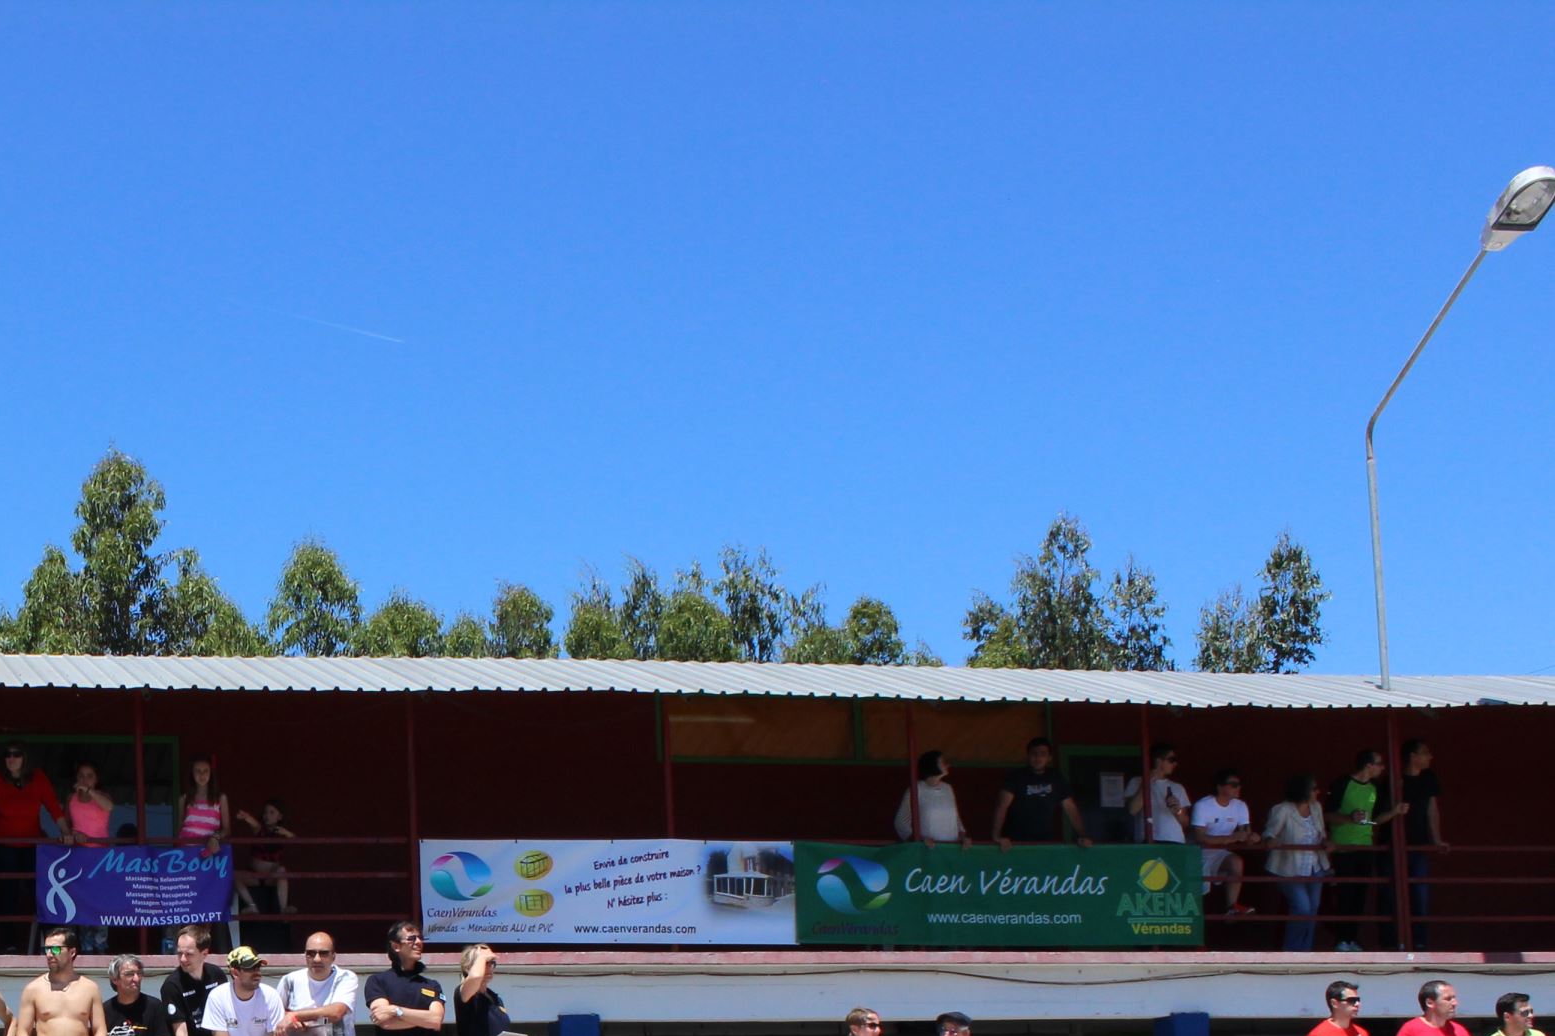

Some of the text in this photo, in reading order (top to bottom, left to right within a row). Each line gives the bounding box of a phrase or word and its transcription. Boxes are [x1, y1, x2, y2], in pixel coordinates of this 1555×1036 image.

[87, 848, 228, 879] Mass Body
[593, 849, 669, 870] Envie de construire
[564, 884, 572, 894] la
[575, 882, 592, 896] plus
[592, 877, 611, 890] belle
[613, 875, 632, 891] pièce
[634, 872, 645, 883] de
[646, 871, 667, 882] votre
[669, 866, 695, 879] maison
[905, 864, 1109, 896] Caen Vérandas
[617, 894, 645, 907] hésitez
[646, 892, 663, 906] plus
[1116, 892, 1201, 917] AKENA
[100, 911, 222, 927] WWW.MASSBODY.PT
[427, 905, 498, 918] CaenVérandas
[927, 912, 1082, 925] www.caenverandas.com
[427, 923, 458, 934] Vérandas
[468, 922, 509, 933] Menuiseries
[509, 923, 526, 933] ALU
[528, 923, 536, 933] et
[537, 923, 554, 933] PVC
[574, 923, 697, 935] www.caenverandas.com
[1131, 921, 1192, 935] Vérandas
